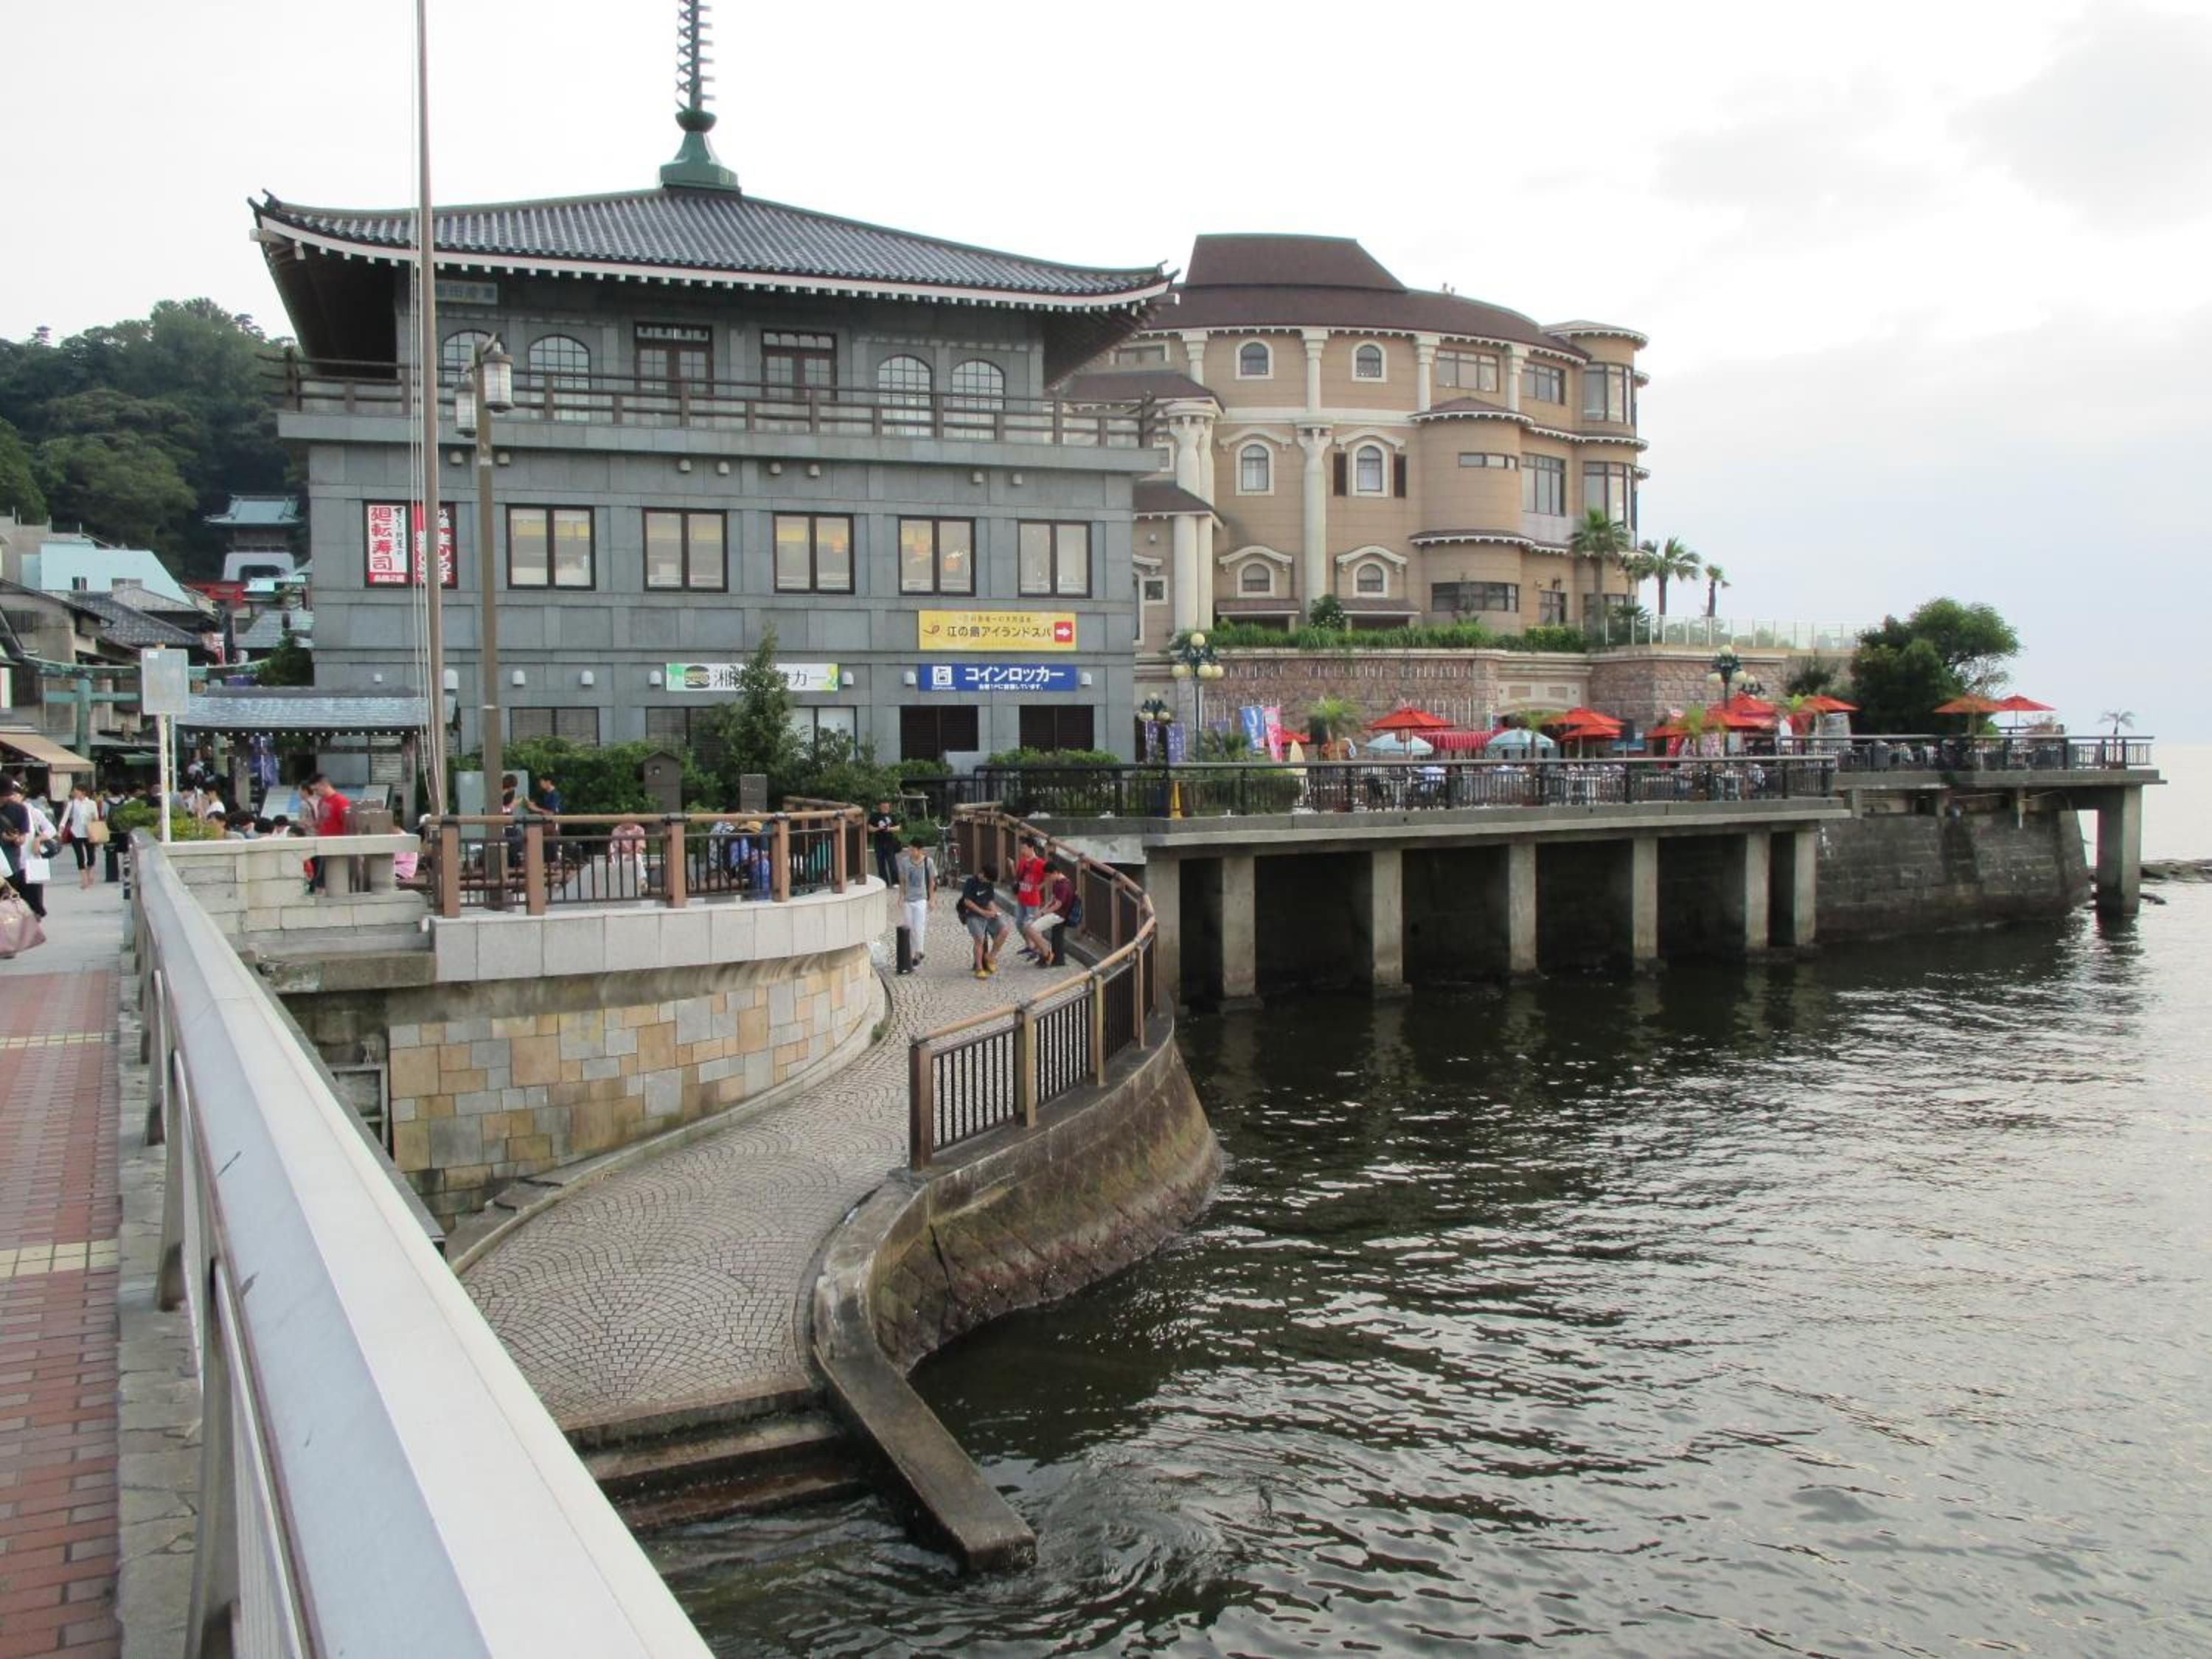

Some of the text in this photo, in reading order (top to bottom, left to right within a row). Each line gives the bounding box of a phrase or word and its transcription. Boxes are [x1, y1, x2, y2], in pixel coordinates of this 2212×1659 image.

[964, 666, 1065, 683] コインロッカー
